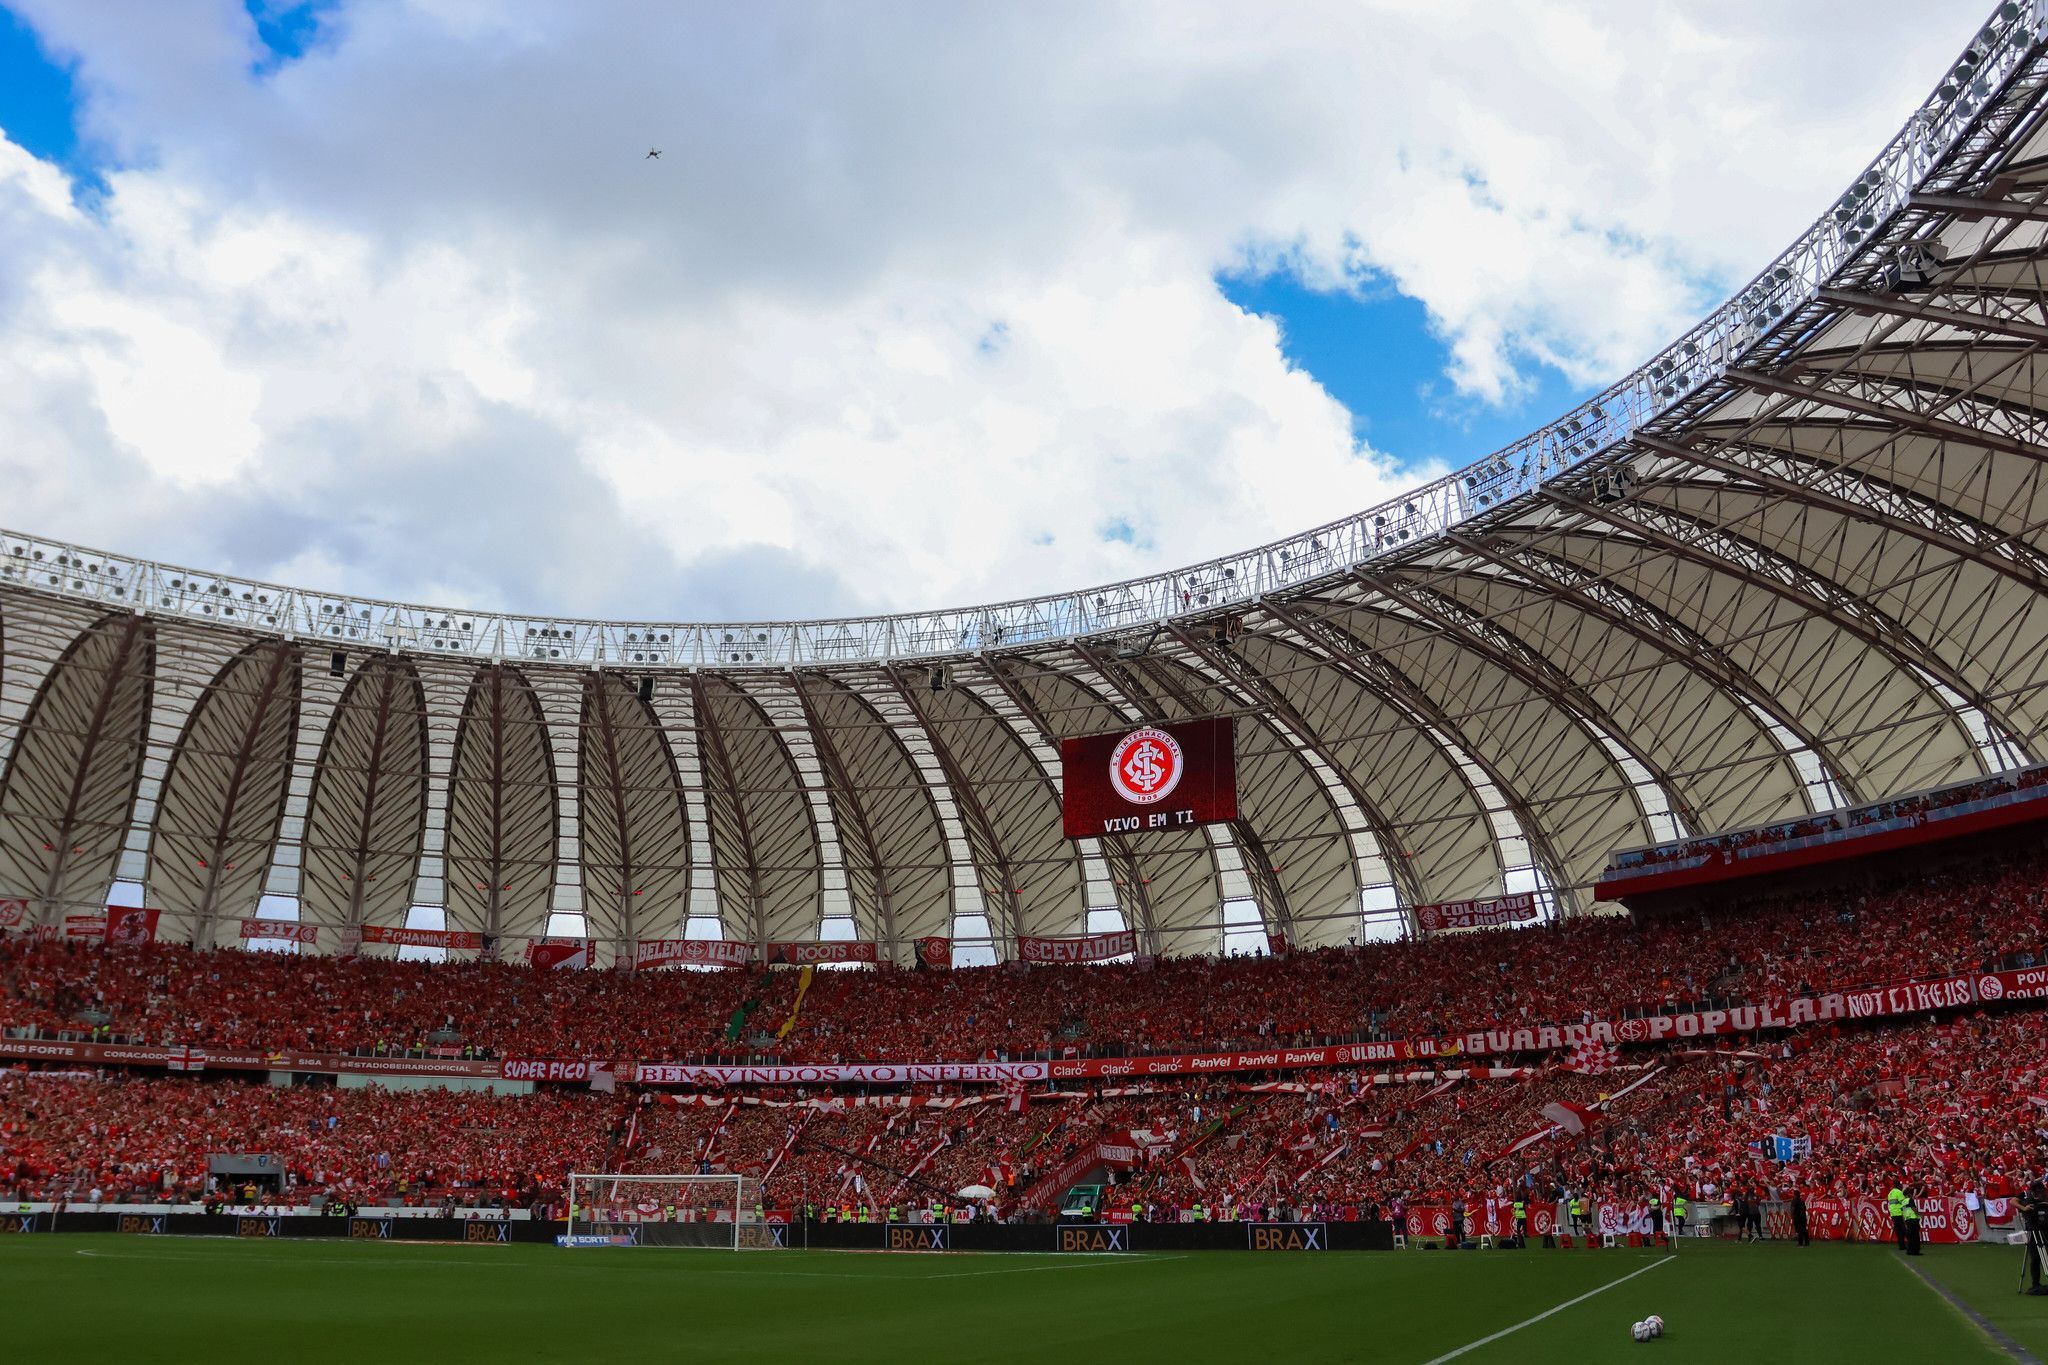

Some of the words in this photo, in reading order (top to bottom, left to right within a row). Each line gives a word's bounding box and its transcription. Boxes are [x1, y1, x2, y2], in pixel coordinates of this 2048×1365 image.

[1137, 794, 1159, 802] 1909
[1104, 816, 1140, 833] VIVO
[1149, 812, 1167, 828] EM
[1175, 809, 1194, 824] TI
[1441, 895, 1531, 917] COLORADO
[1447, 916, 1472, 928] 24
[1474, 908, 1532, 926] HORAS
[257, 923, 300, 938] 317
[393, 928, 451, 948] CHAMINÉ
[638, 940, 683, 963] BELÉM
[796, 943, 847, 961] ROOTS
[1039, 932, 1134, 960] CEVADOS
[2016, 970, 2048, 986] POV
[1848, 992, 1885, 1018] NOT
[1649, 993, 1846, 1040] POPULAR
[28, 1045, 74, 1056] FORTE
[1053, 1062, 1085, 1076] Claro
[1100, 1060, 1132, 1075] Claro
[1148, 1058, 1181, 1073] Claro
[1191, 1056, 1231, 1069] PanVel
[1238, 1053, 1279, 1067] PanVel
[1284, 1051, 1325, 1064] PanVel
[1351, 1044, 1396, 1061] ULBRA
[298, 1058, 323, 1067] SIGA
[504, 1060, 546, 1080] SUPER
[549, 1061, 586, 1080] FICO
[714, 1066, 841, 1083] VINDOS
[850, 1067, 897, 1082] AO
[904, 1064, 1043, 1081] INFERNO
[122, 1217, 163, 1234] BRAX
[240, 1219, 277, 1236] BRAX
[351, 1221, 389, 1239] BRAX
[467, 1223, 508, 1242] BRAX
[578, 1235, 610, 1243] SORTE
[890, 1229, 944, 1249] BRAX
[1063, 1229, 1123, 1250] BRAX
[1255, 1228, 1320, 1250] BRAX
